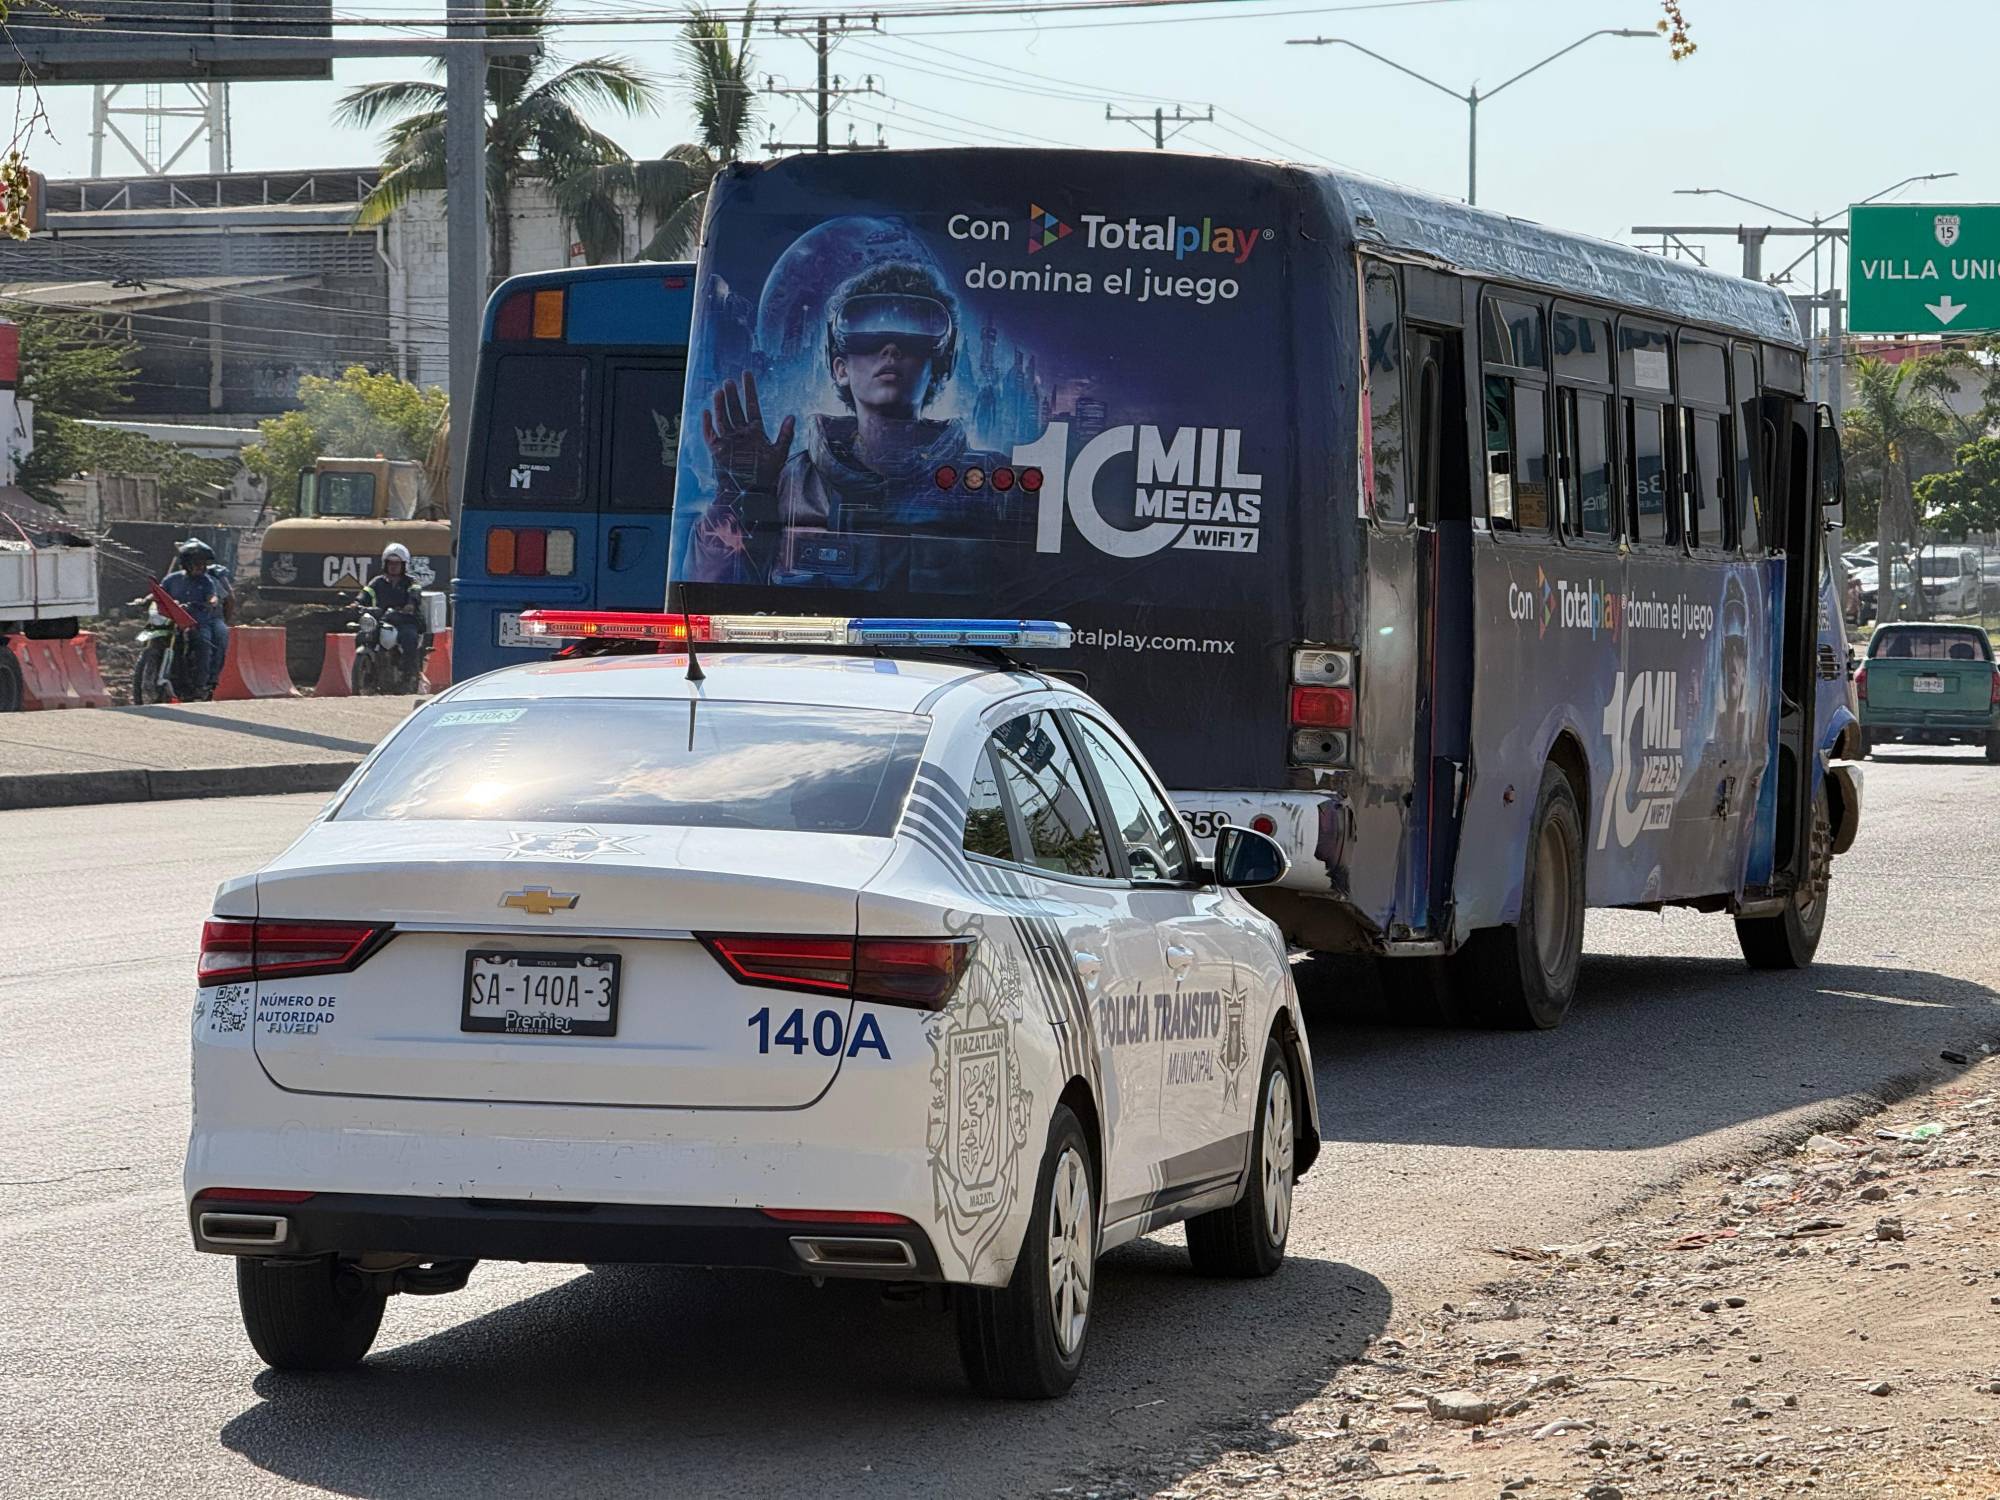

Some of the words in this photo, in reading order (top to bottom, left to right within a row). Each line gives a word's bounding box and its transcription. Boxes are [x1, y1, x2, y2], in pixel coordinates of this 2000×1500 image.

[948, 214, 1010, 241] Con
[1941, 227, 1954, 238] 15
[965, 262, 1092, 294] domina
[1103, 268, 1131, 294] el
[1138, 268, 1239, 305] juego
[1861, 260, 1939, 280] VILLA
[1951, 260, 2000, 280] UNI
[1136, 425, 1262, 489] MIL
[1012, 421, 1185, 558] 10
[1135, 488, 1262, 524] MEGAS
[1193, 530, 1235, 548] WIFI
[1240, 532, 1254, 549] 7
[322, 555, 372, 588] CAT
[1508, 582, 1534, 620] Con
[1627, 591, 1669, 629] domina
[1671, 594, 1681, 629] el
[1682, 593, 1714, 640] juego
[1069, 628, 1235, 654] otalplay.com.mx
[1642, 671, 1681, 749] MIL
[260, 993, 314, 1007] NÚMERO
[318, 996, 337, 1007] DE
[471, 973, 612, 1008] SA-140A-3
[257, 1011, 335, 1023] AUTORIDAD
[505, 1010, 572, 1030] Premier
[1099, 981, 1149, 1048] POLICÍA
[1154, 981, 1221, 1041] TRÁNSITO
[748, 1007, 892, 1060] 140A
[1167, 1050, 1213, 1086] MUNICIPAL
